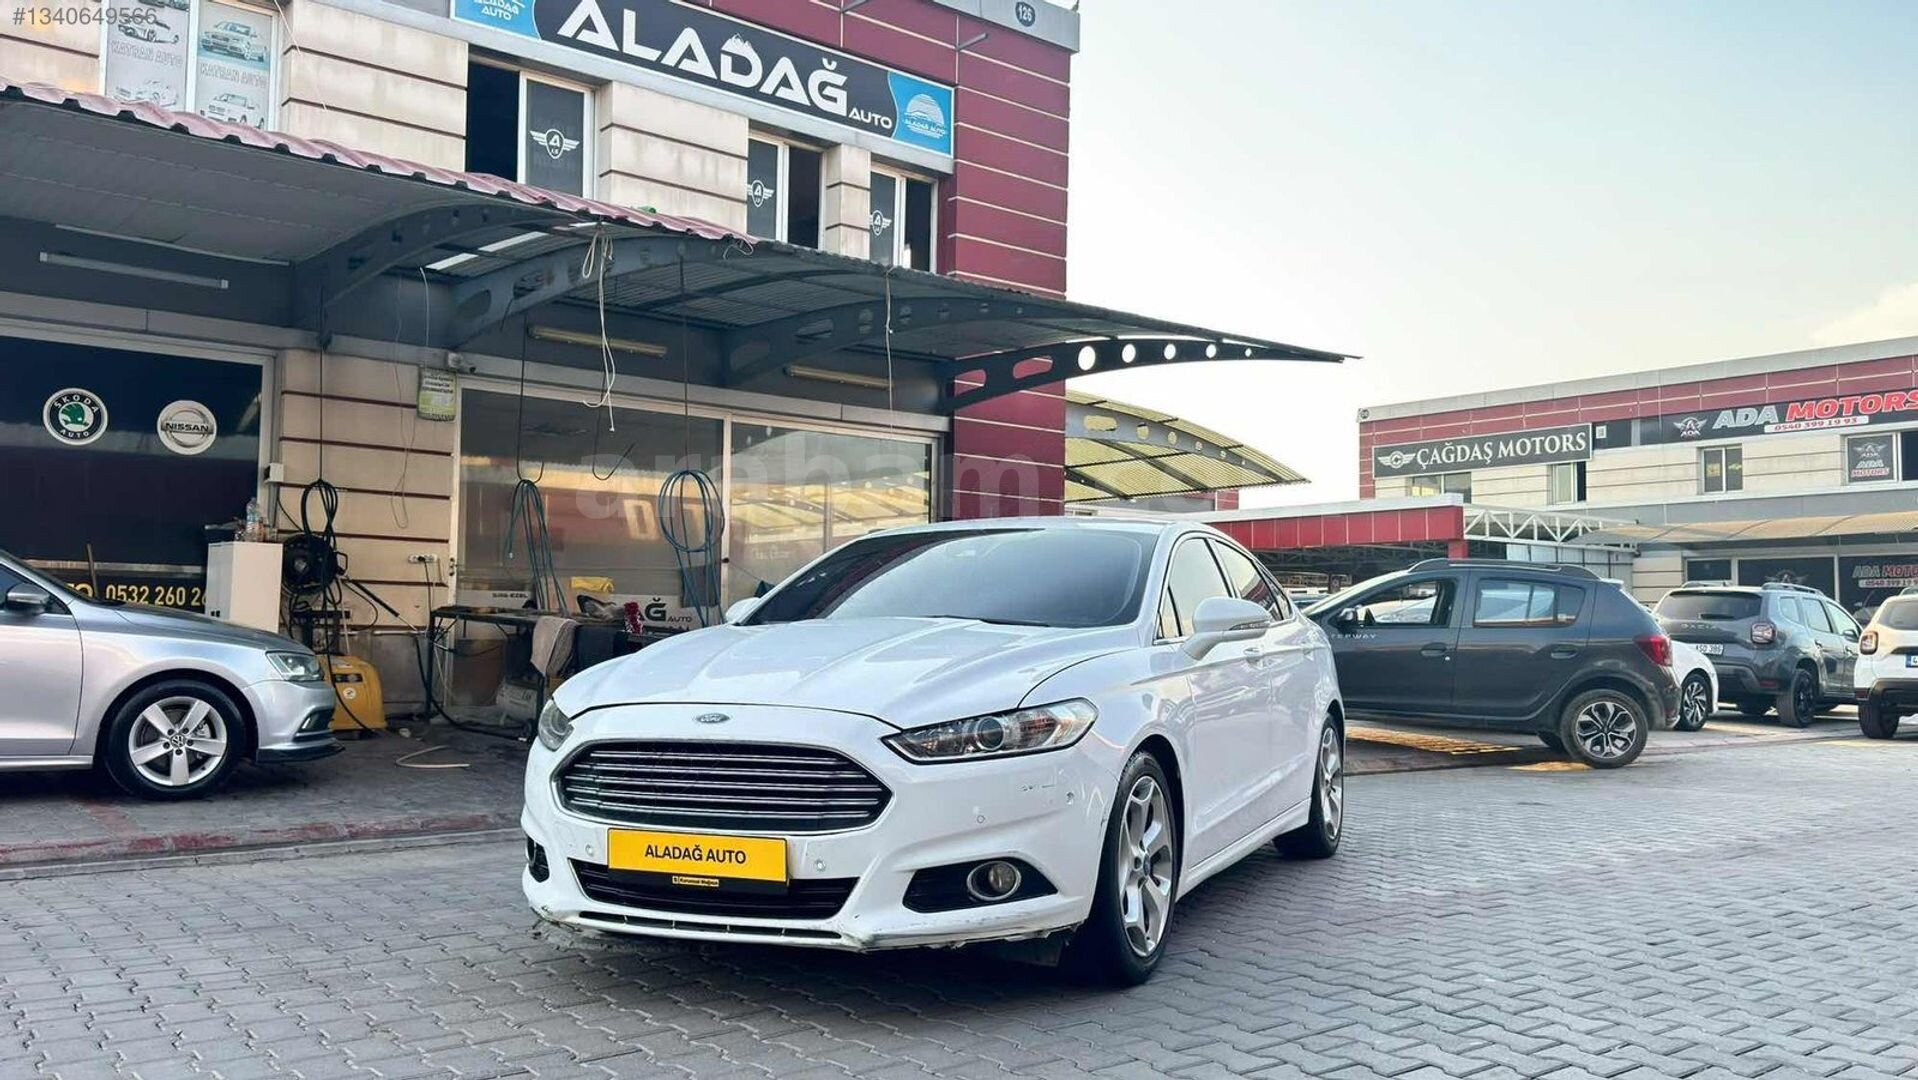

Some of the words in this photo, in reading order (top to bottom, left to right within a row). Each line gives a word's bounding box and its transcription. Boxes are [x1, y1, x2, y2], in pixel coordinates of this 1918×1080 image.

[481, 6, 513, 21] AUTO
[1018, 3, 1034, 22] 126
[556, 0, 849, 118] ALADAĞ
[848, 107, 893, 130] AUTO
[165, 422, 209, 433] NISSAN
[1712, 405, 1779, 430] ADA
[59, 429, 90, 439] AUTO
[1416, 441, 1494, 470] ÇAĞDAŞ
[1498, 432, 1586, 458] MOTORS
[105, 584, 149, 604] 0532
[154, 586, 186, 606] 260
[667, 615, 693, 623] AUTO
[644, 843, 703, 861] ALADAĞ
[705, 848, 747, 864] AUTO
